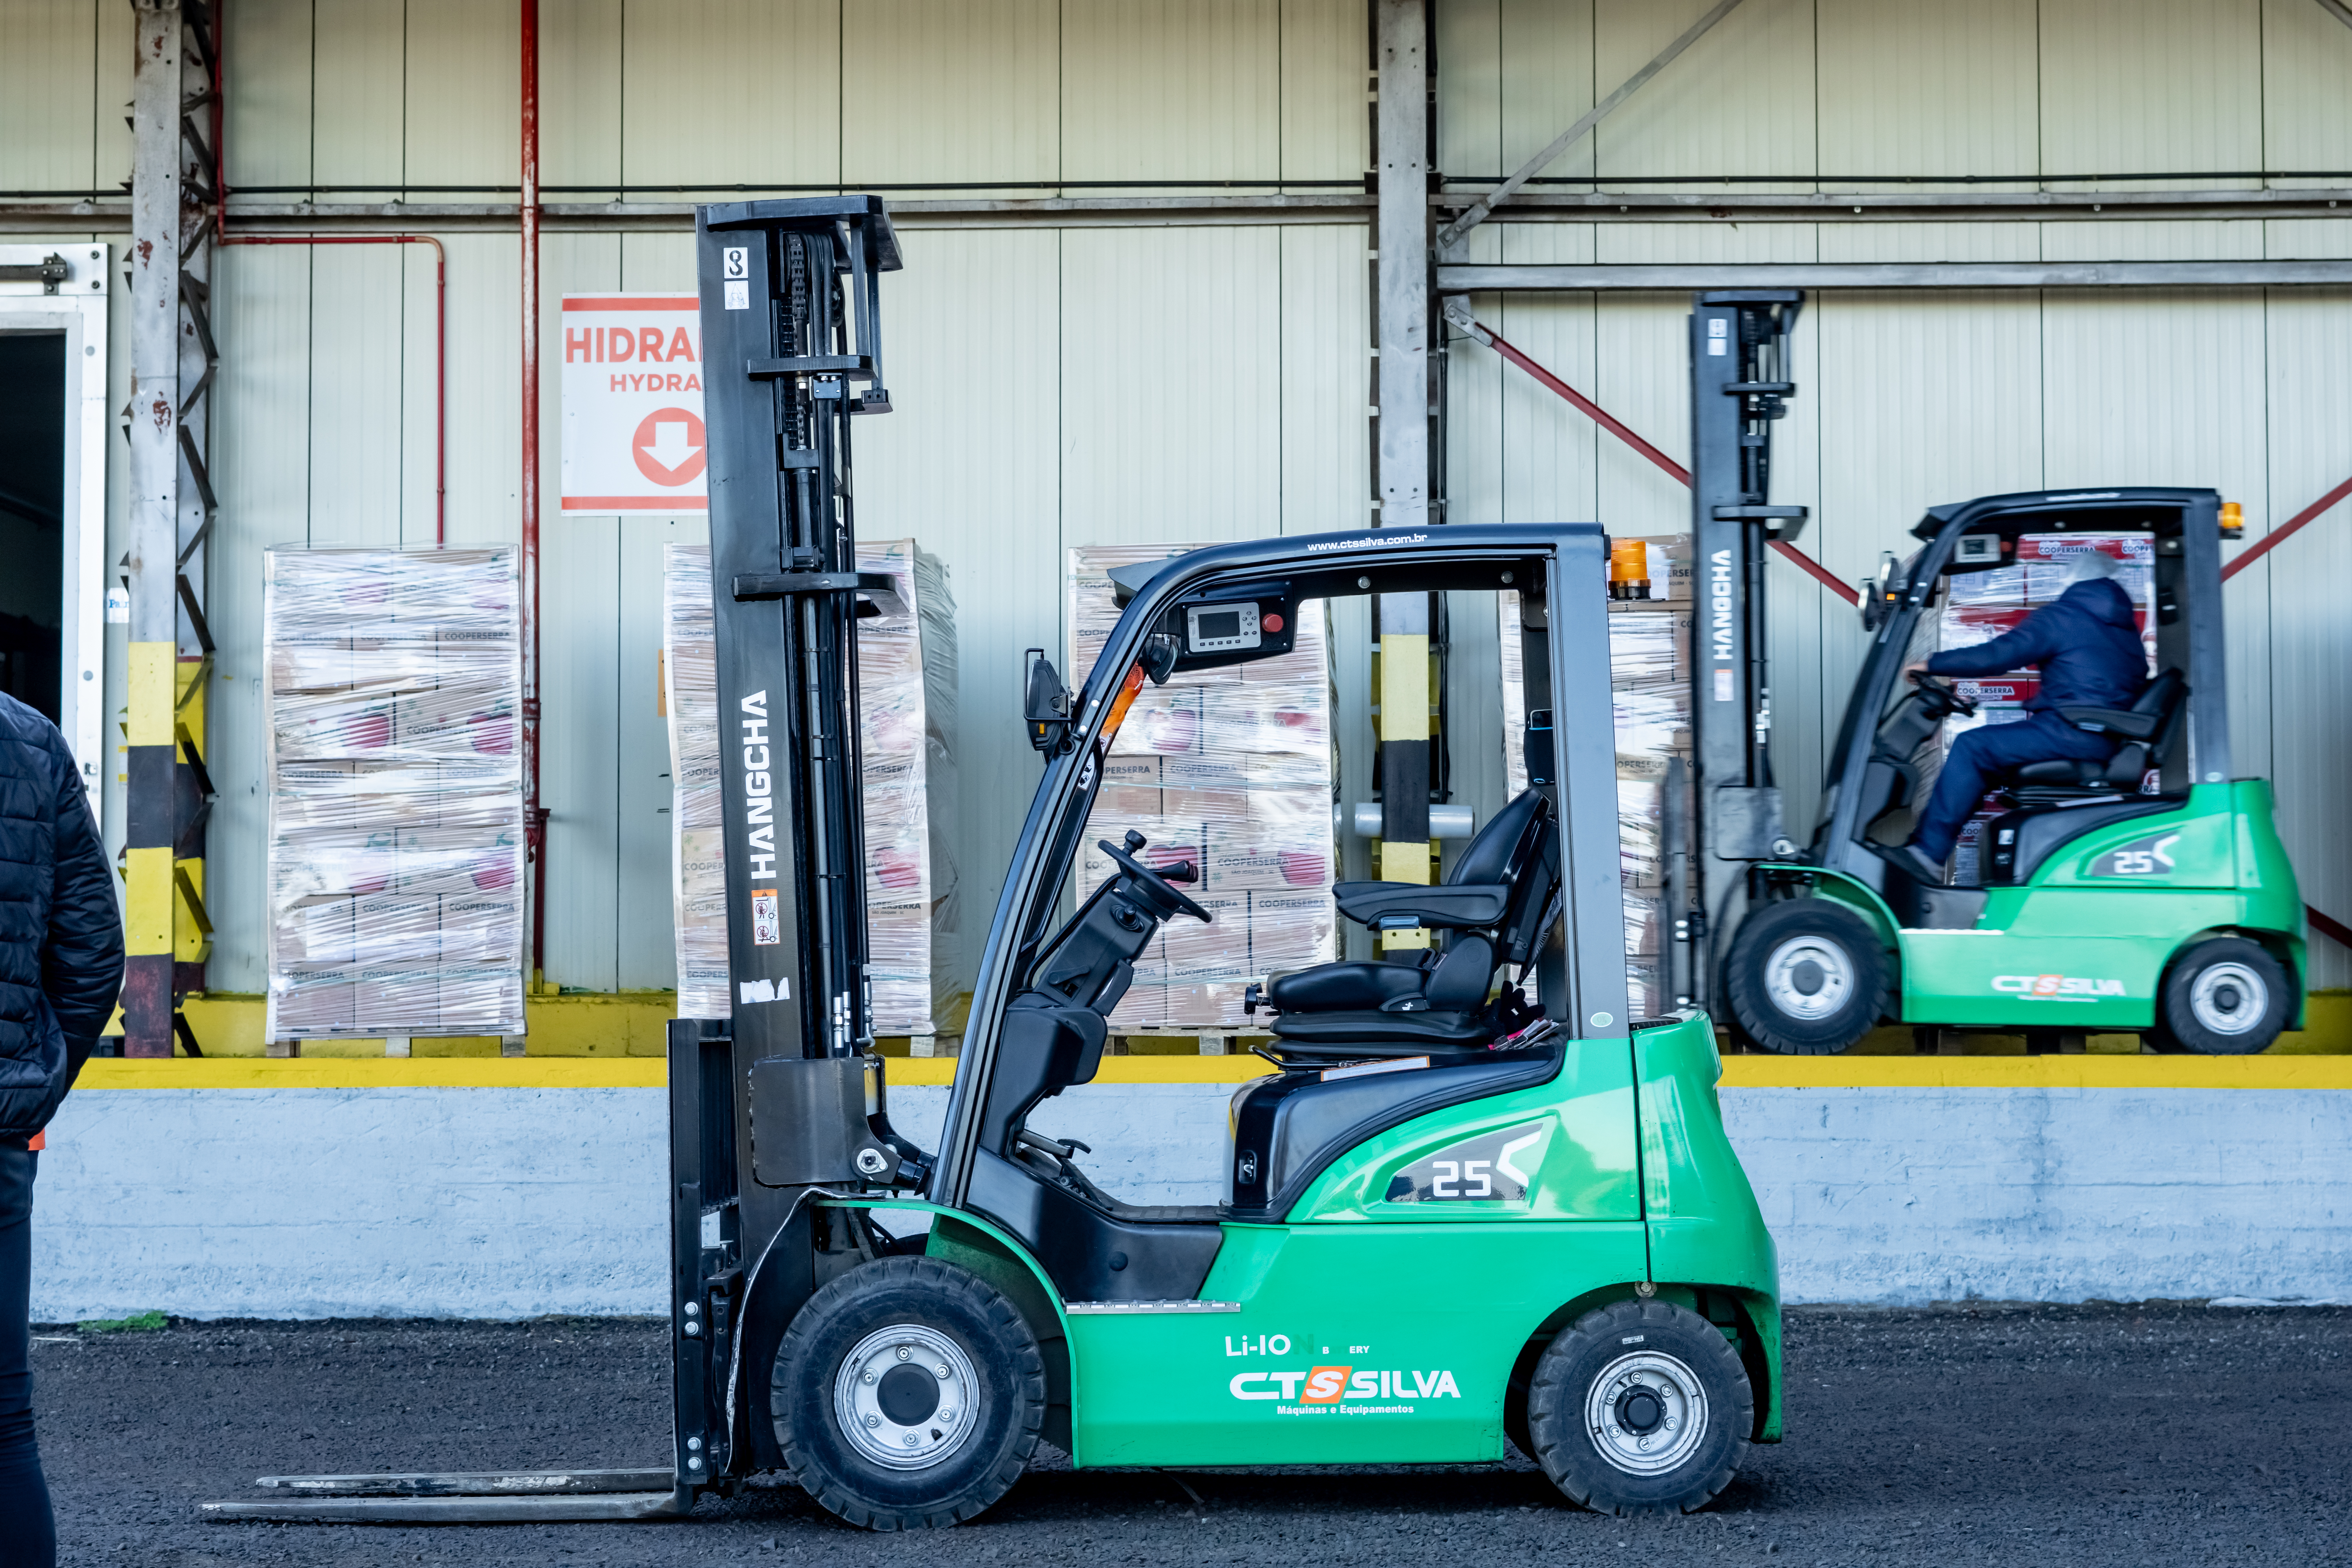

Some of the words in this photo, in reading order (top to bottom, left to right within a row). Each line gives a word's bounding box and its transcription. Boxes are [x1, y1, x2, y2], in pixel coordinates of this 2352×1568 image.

[1307, 534, 1427, 551] www.ctssilva.com.br
[740, 690, 776, 879] HANGCHA
[1218, 857, 1289, 866] COOPERSERRA
[2114, 851, 2153, 873] 25
[1433, 1160, 1491, 1197] 25
[1277, 1405, 1327, 1416] Máquinas
[1340, 1404, 1414, 1415] Equipamentos
